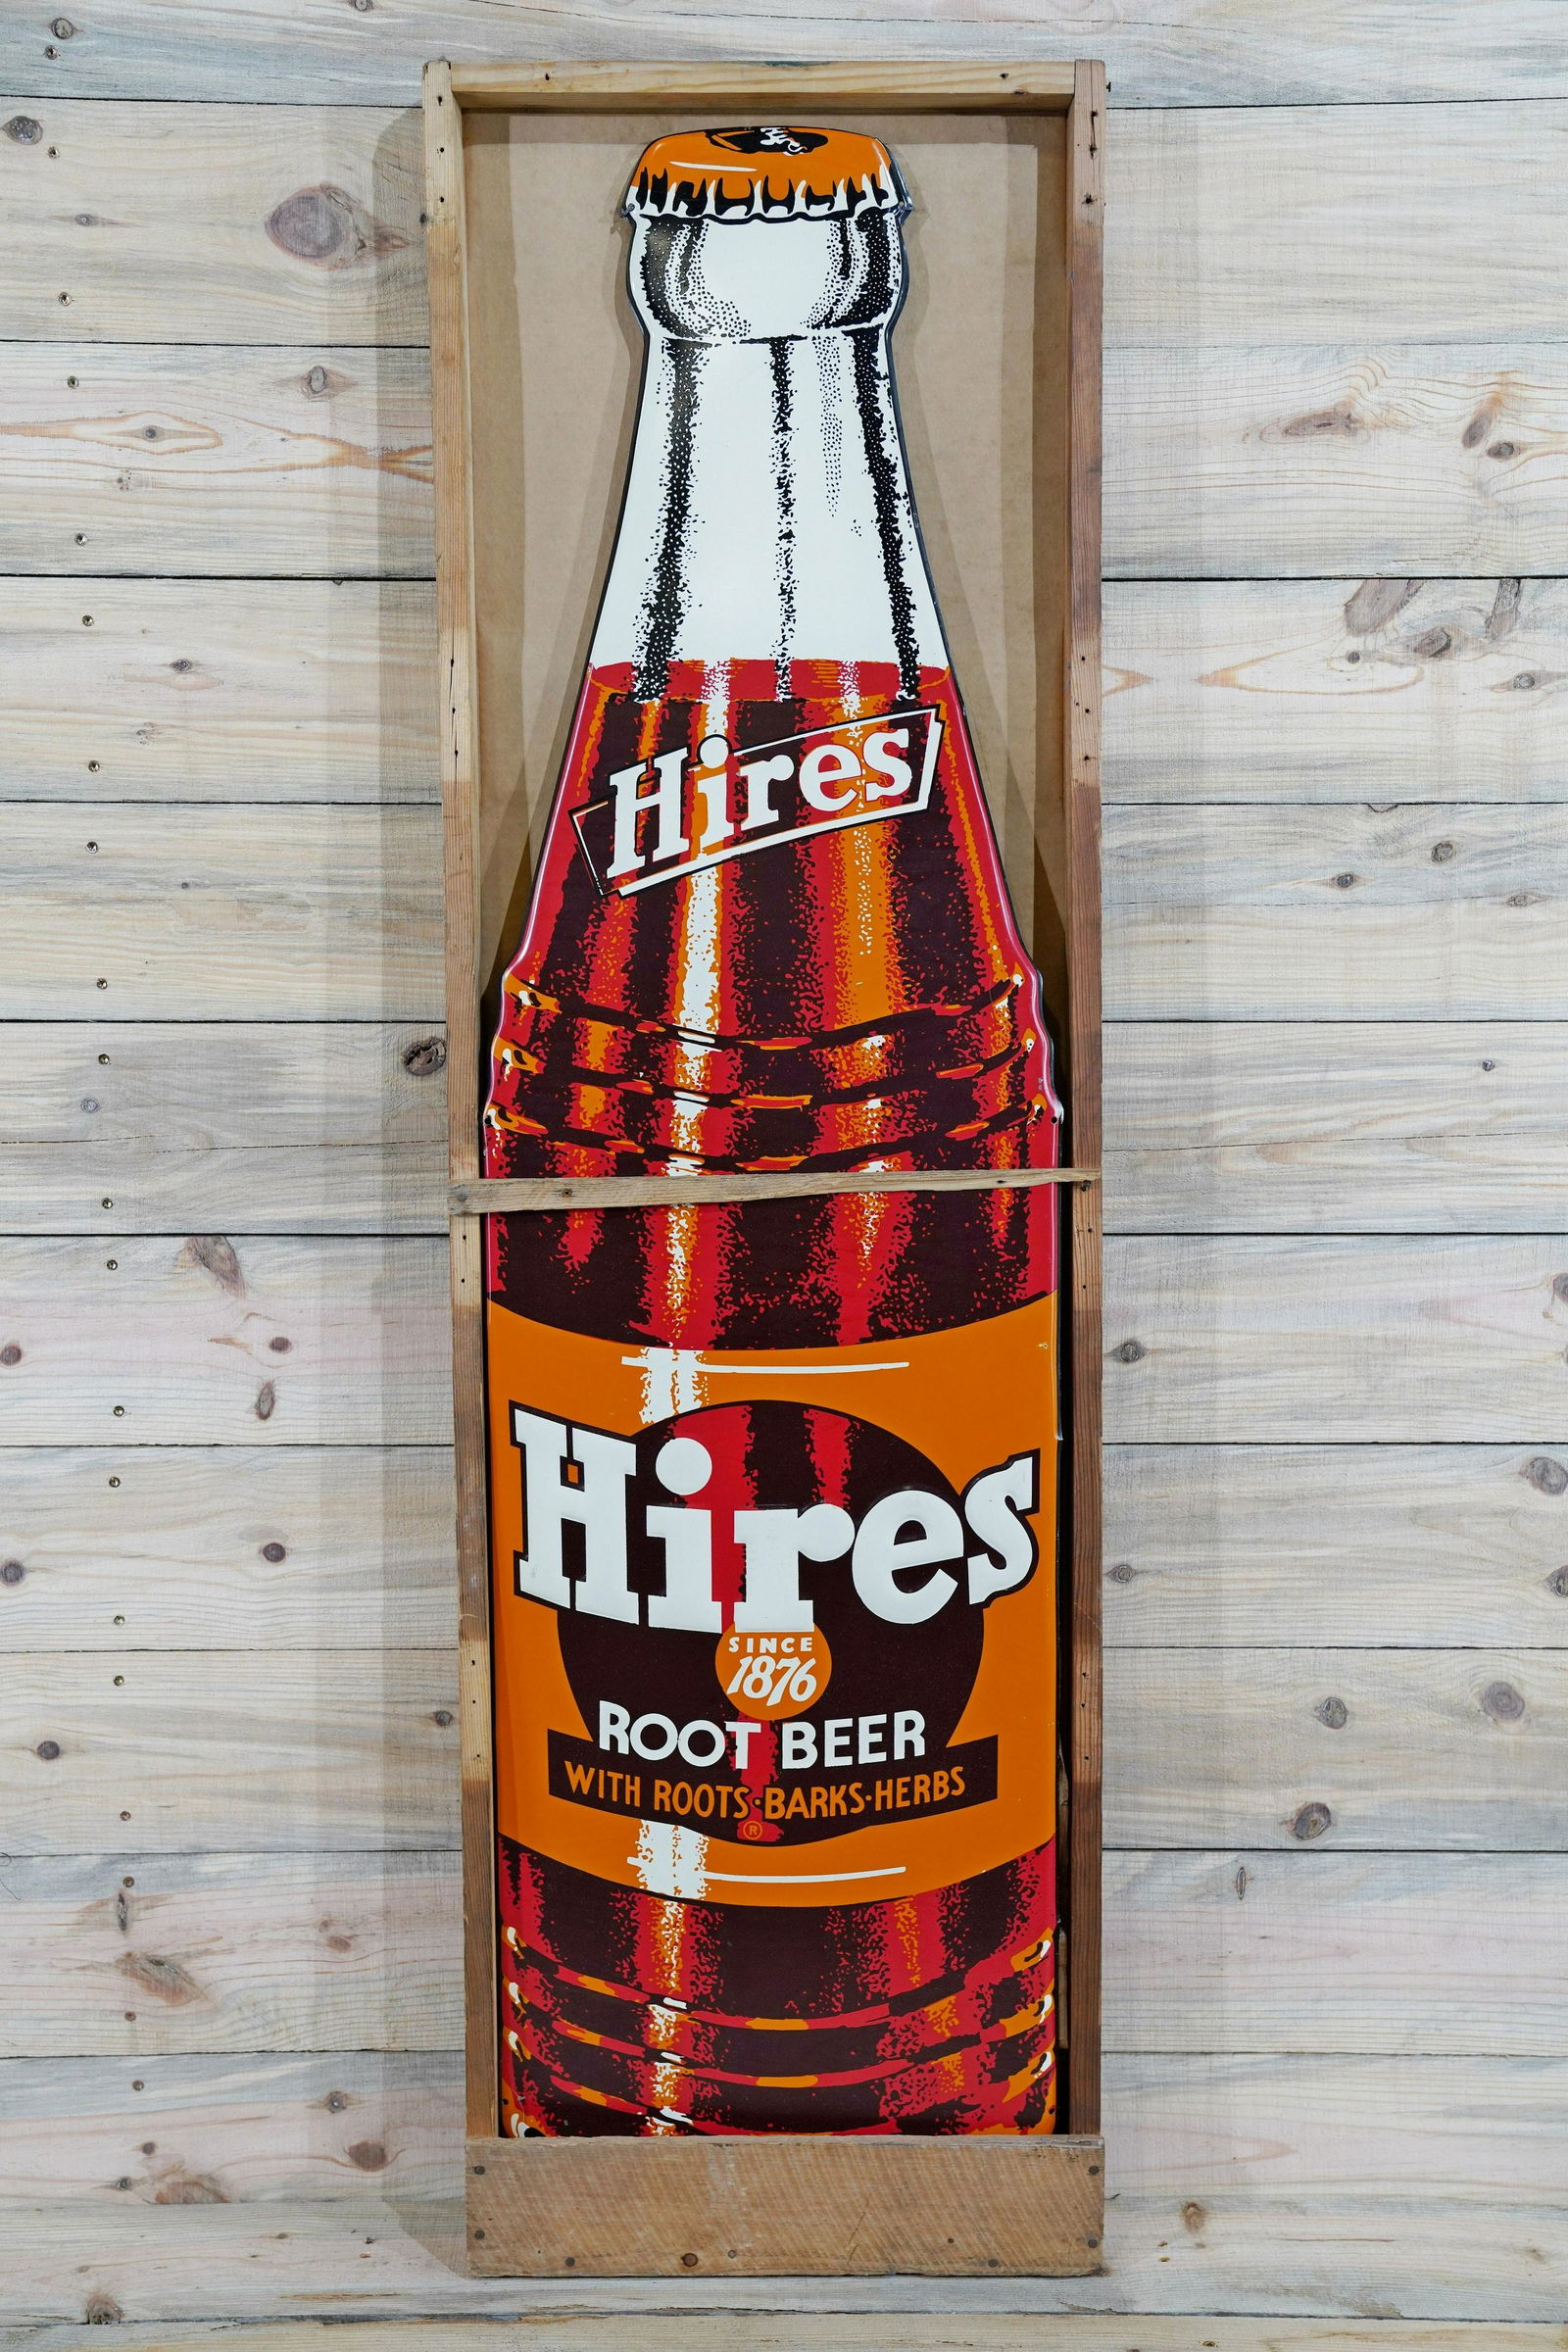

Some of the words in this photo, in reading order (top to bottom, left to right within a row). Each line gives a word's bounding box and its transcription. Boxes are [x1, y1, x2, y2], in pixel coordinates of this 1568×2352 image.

[606, 728, 913, 879] Hires
[514, 1409, 1034, 1634] Hires
[728, 1637, 812, 1653] SINCE
[726, 1655, 817, 1706] 1876
[599, 1699, 761, 1769] ROOT
[782, 1710, 926, 1769] BEER
[564, 1761, 641, 1807] WITH
